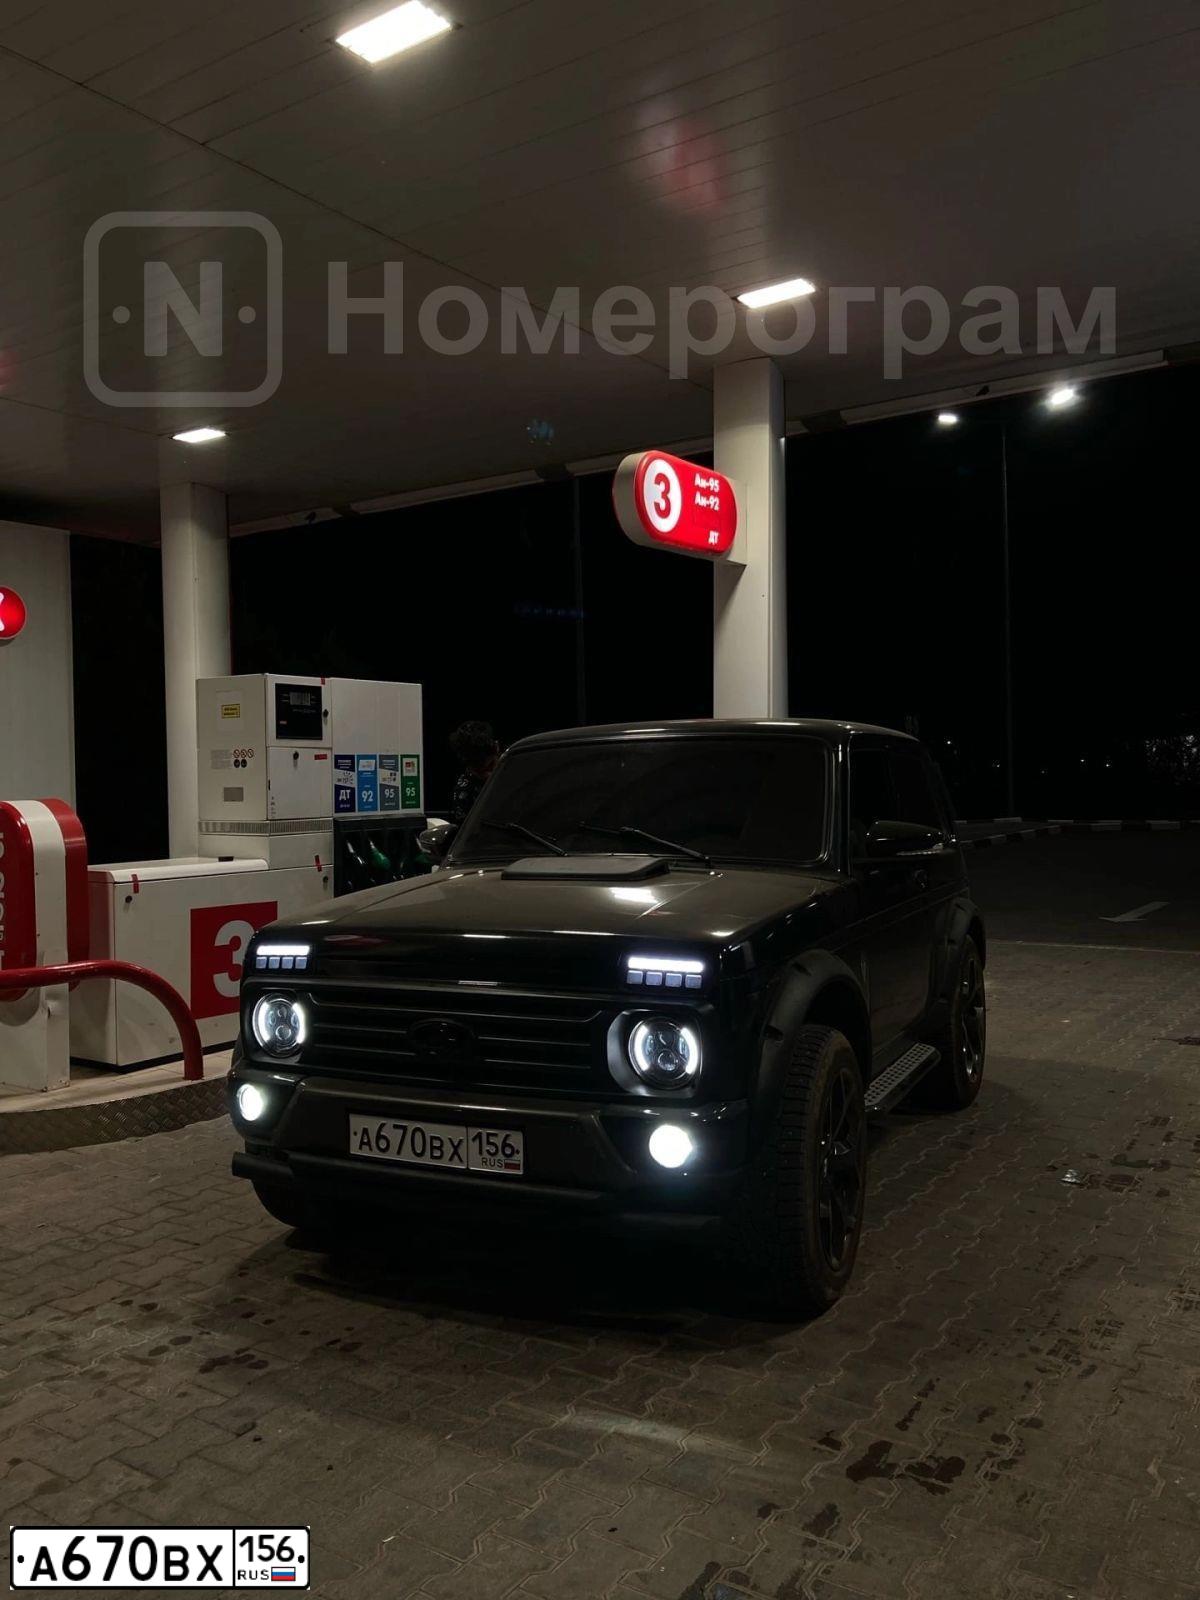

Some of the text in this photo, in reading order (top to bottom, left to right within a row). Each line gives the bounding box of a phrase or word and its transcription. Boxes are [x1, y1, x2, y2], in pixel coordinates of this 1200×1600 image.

[653, 472, 672, 519] 3
[339, 789, 351, 801] ДТ
[361, 790, 374, 803] 92
[384, 788, 395, 799] 95
[405, 787, 416, 797] 95
[213, 920, 255, 998] 3
[358, 1121, 515, 1164] А670ВХ 156
[481, 1157, 504, 1169] RUS
